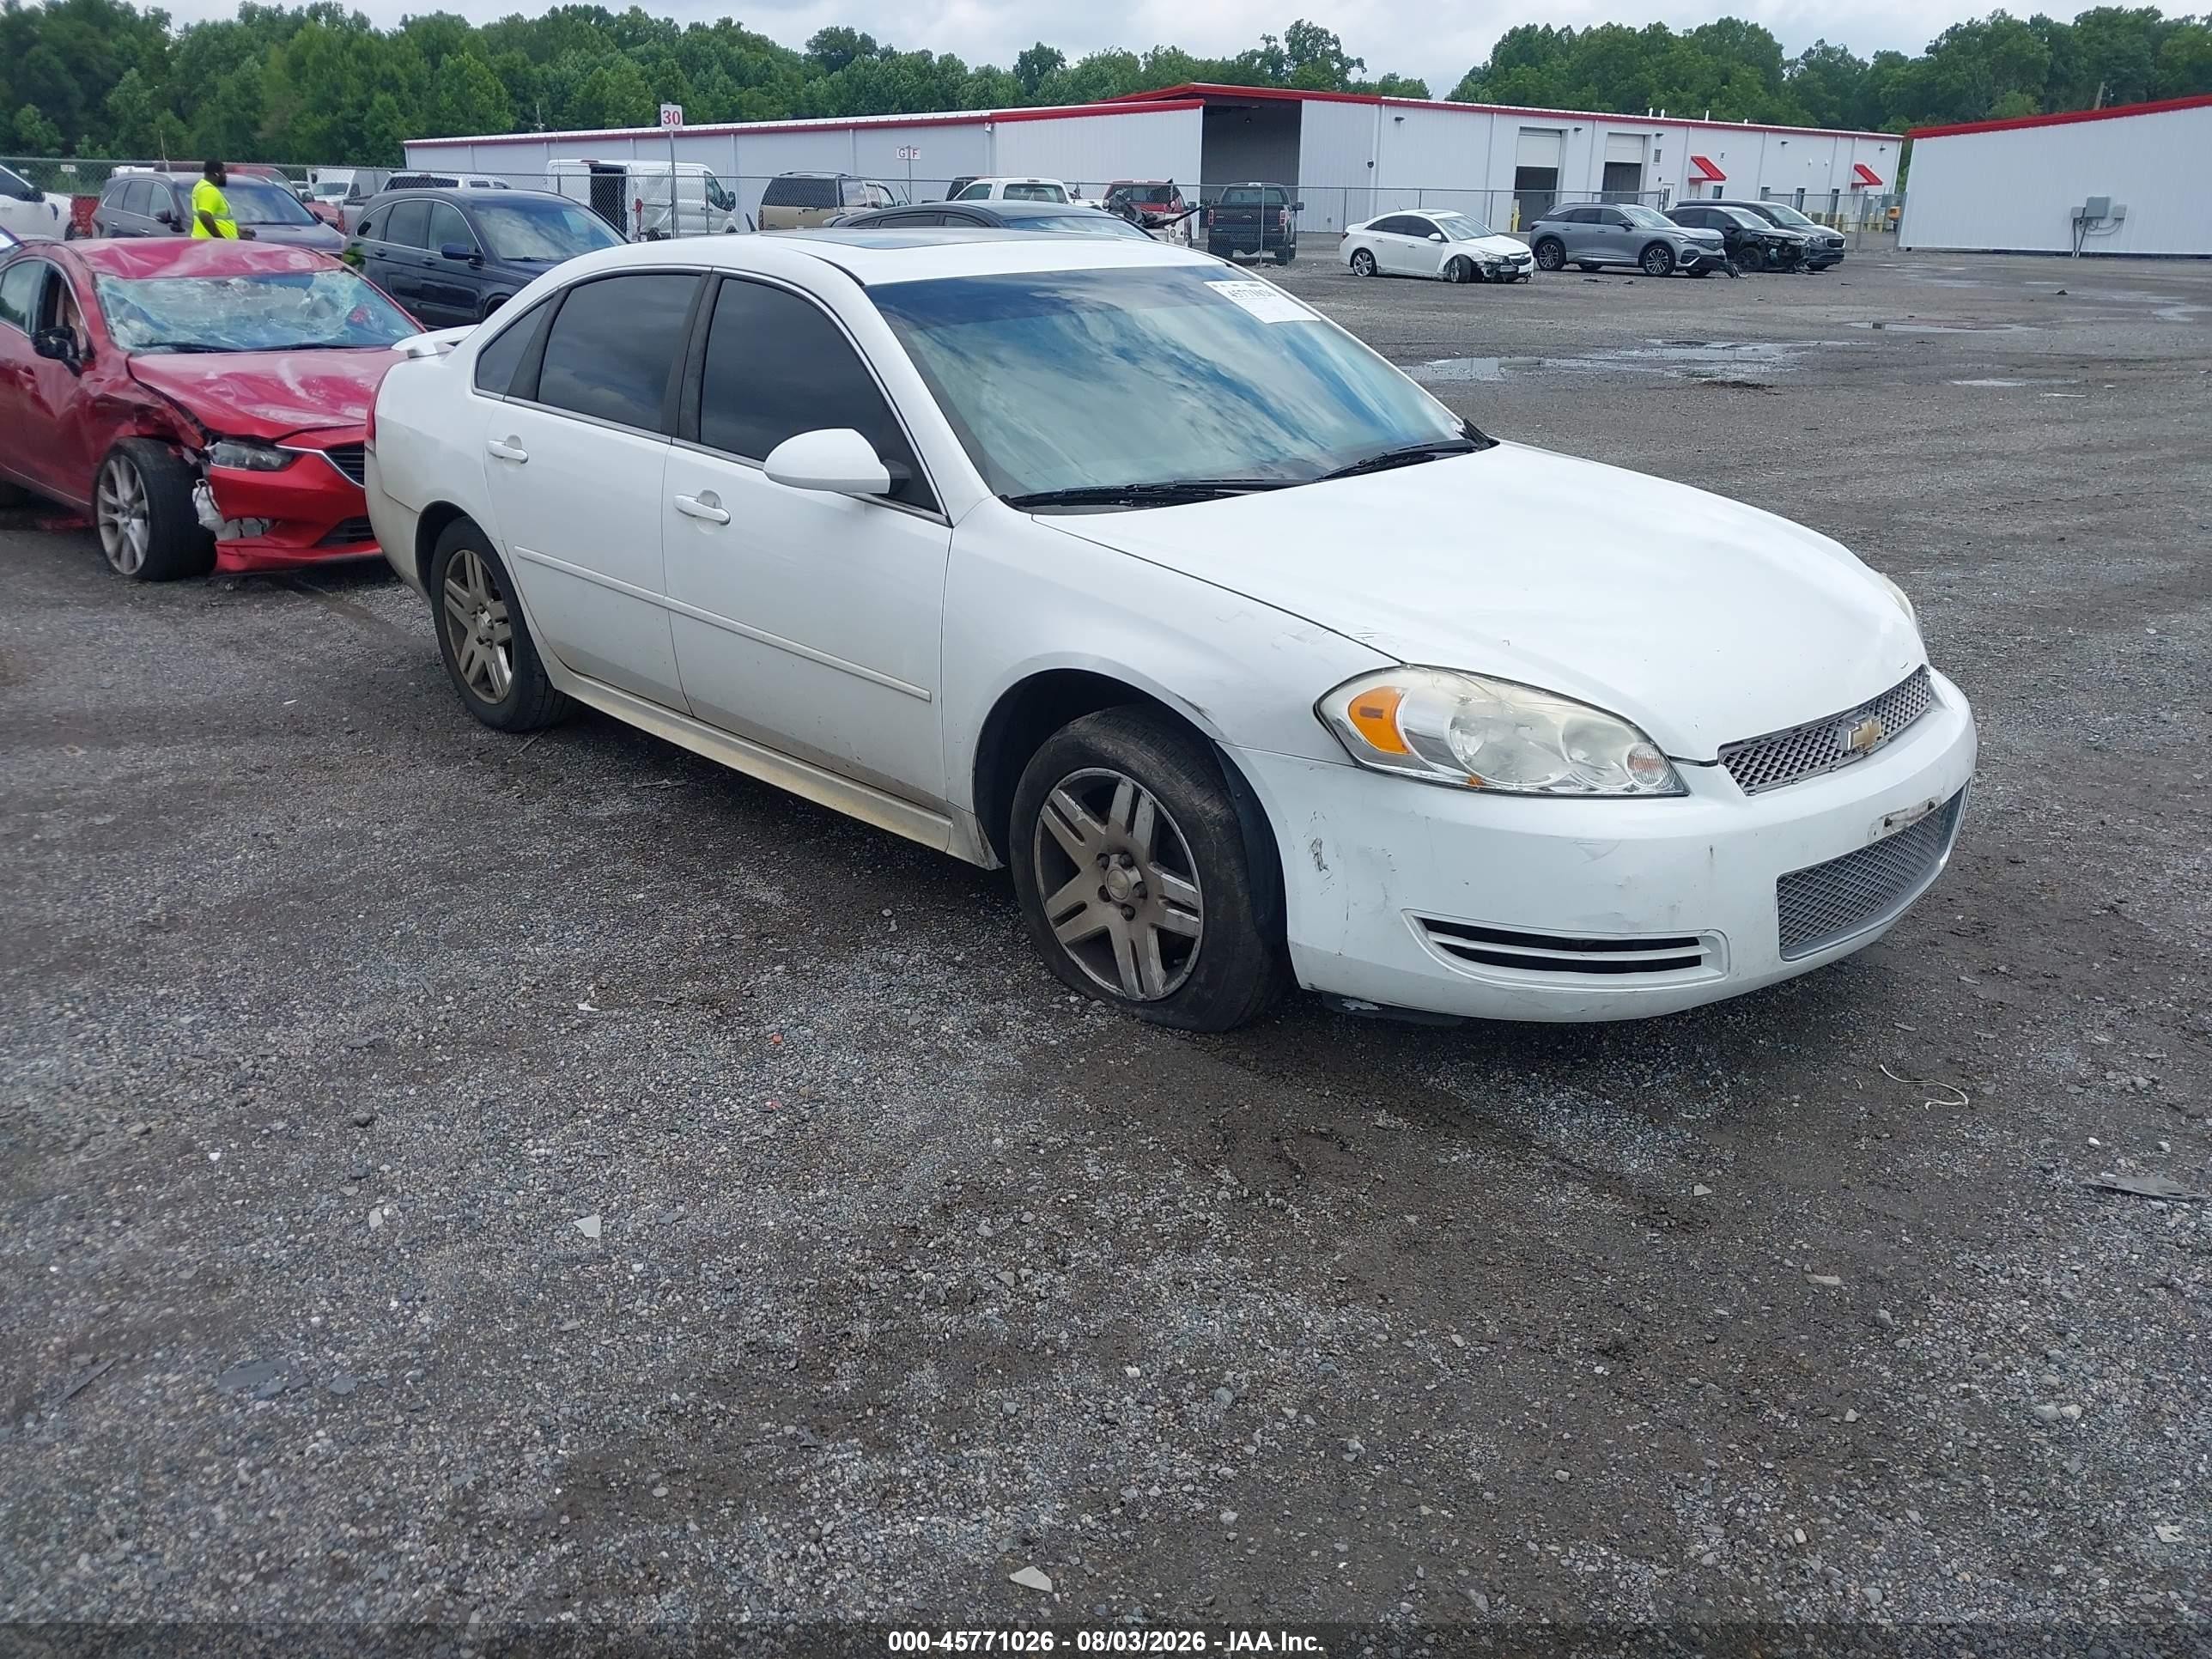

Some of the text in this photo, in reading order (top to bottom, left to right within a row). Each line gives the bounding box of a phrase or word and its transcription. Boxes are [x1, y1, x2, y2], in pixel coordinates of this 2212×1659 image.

[663, 110, 681, 125] 30
[898, 148, 918, 159] G F
